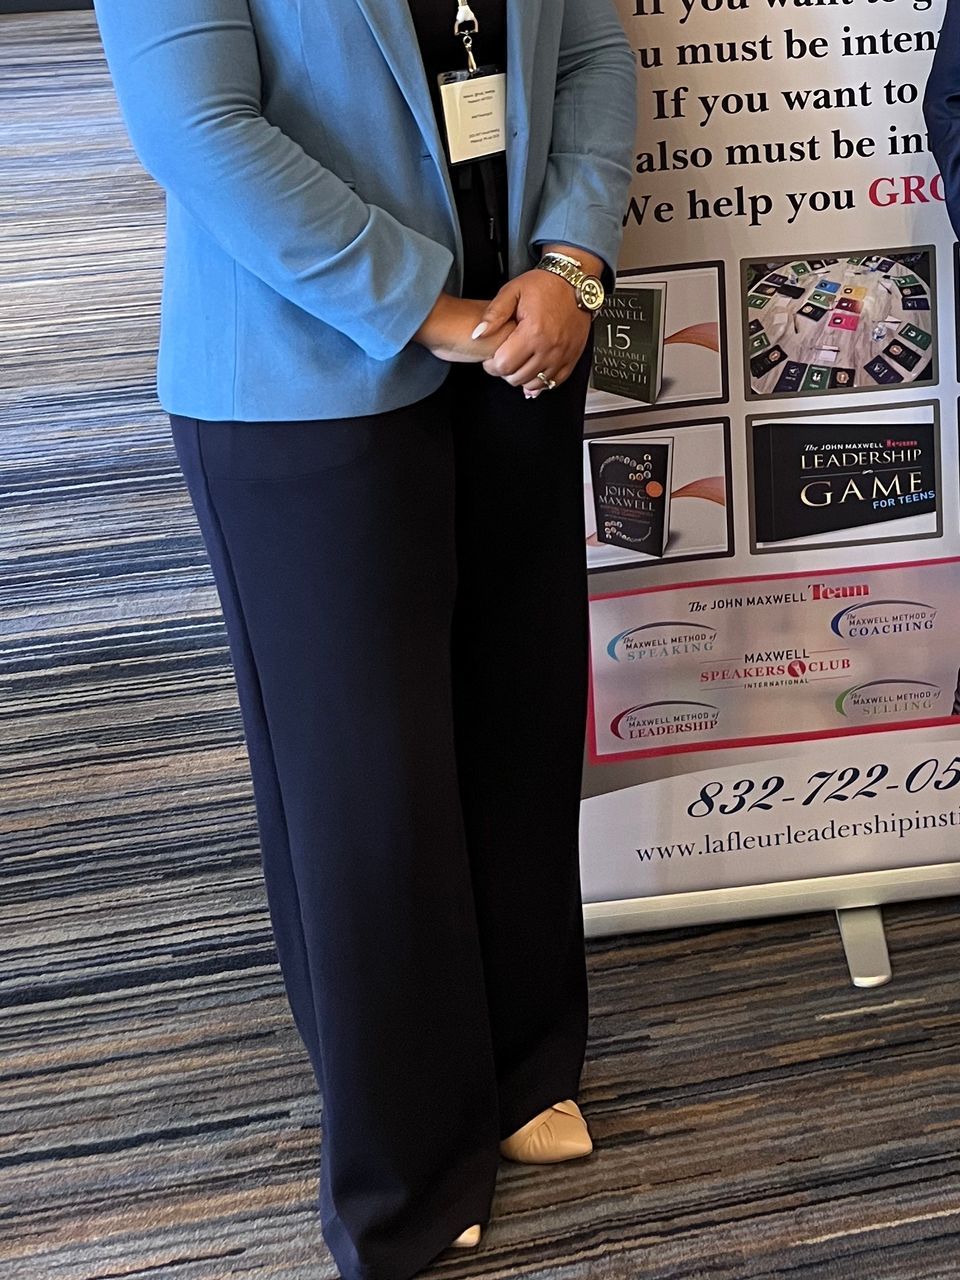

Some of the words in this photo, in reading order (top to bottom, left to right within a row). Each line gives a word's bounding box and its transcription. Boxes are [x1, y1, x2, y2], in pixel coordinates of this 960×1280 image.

[632, 47, 663, 68] u
[676, 34, 773, 65] must
[784, 29, 828, 59] be
[841, 26, 941, 57] inten
[652, 86, 689, 120] If
[698, 92, 769, 127] you
[781, 82, 873, 110] want
[884, 80, 918, 105] to
[636, 141, 713, 174] also
[725, 136, 820, 165] must
[831, 129, 875, 160] be
[622, 195, 674, 227] We
[686, 186, 773, 227] help
[786, 190, 855, 224] you
[608, 324, 631, 350] 15
[594, 355, 627, 370] LAWS
[629, 362, 647, 373] OF
[595, 365, 647, 384] GROWTH
[801, 449, 922, 470] LEADERSHIP
[605, 485, 635, 497] JOHN
[800, 472, 923, 507] GAME
[599, 495, 656, 511] MAXWELL
[873, 497, 896, 510] FOR
[898, 490, 936, 505] TEENS
[689, 602, 707, 612] The
[711, 597, 743, 610] JOHN
[746, 592, 807, 606] MAXWELL
[808, 583, 870, 601] Team
[849, 616, 889, 626] MAXWELL
[892, 612, 926, 622] METHOD
[848, 620, 934, 638] COACHING
[625, 638, 667, 650] MAXWELL
[670, 634, 706, 644] METHOD
[627, 642, 714, 662] SPEAKING
[744, 649, 810, 663] MAXWELL
[700, 664, 785, 683] SPEAKERS
[808, 658, 851, 672] CLUB
[744, 678, 809, 689] INTERNATIONAL
[853, 696, 893, 706] MAXWELL
[896, 691, 931, 701] METHOD
[863, 700, 933, 716] SELLING
[628, 717, 670, 729] MAXWELL
[673, 712, 709, 722] METHOD
[629, 720, 718, 739] LEADERSHIP
